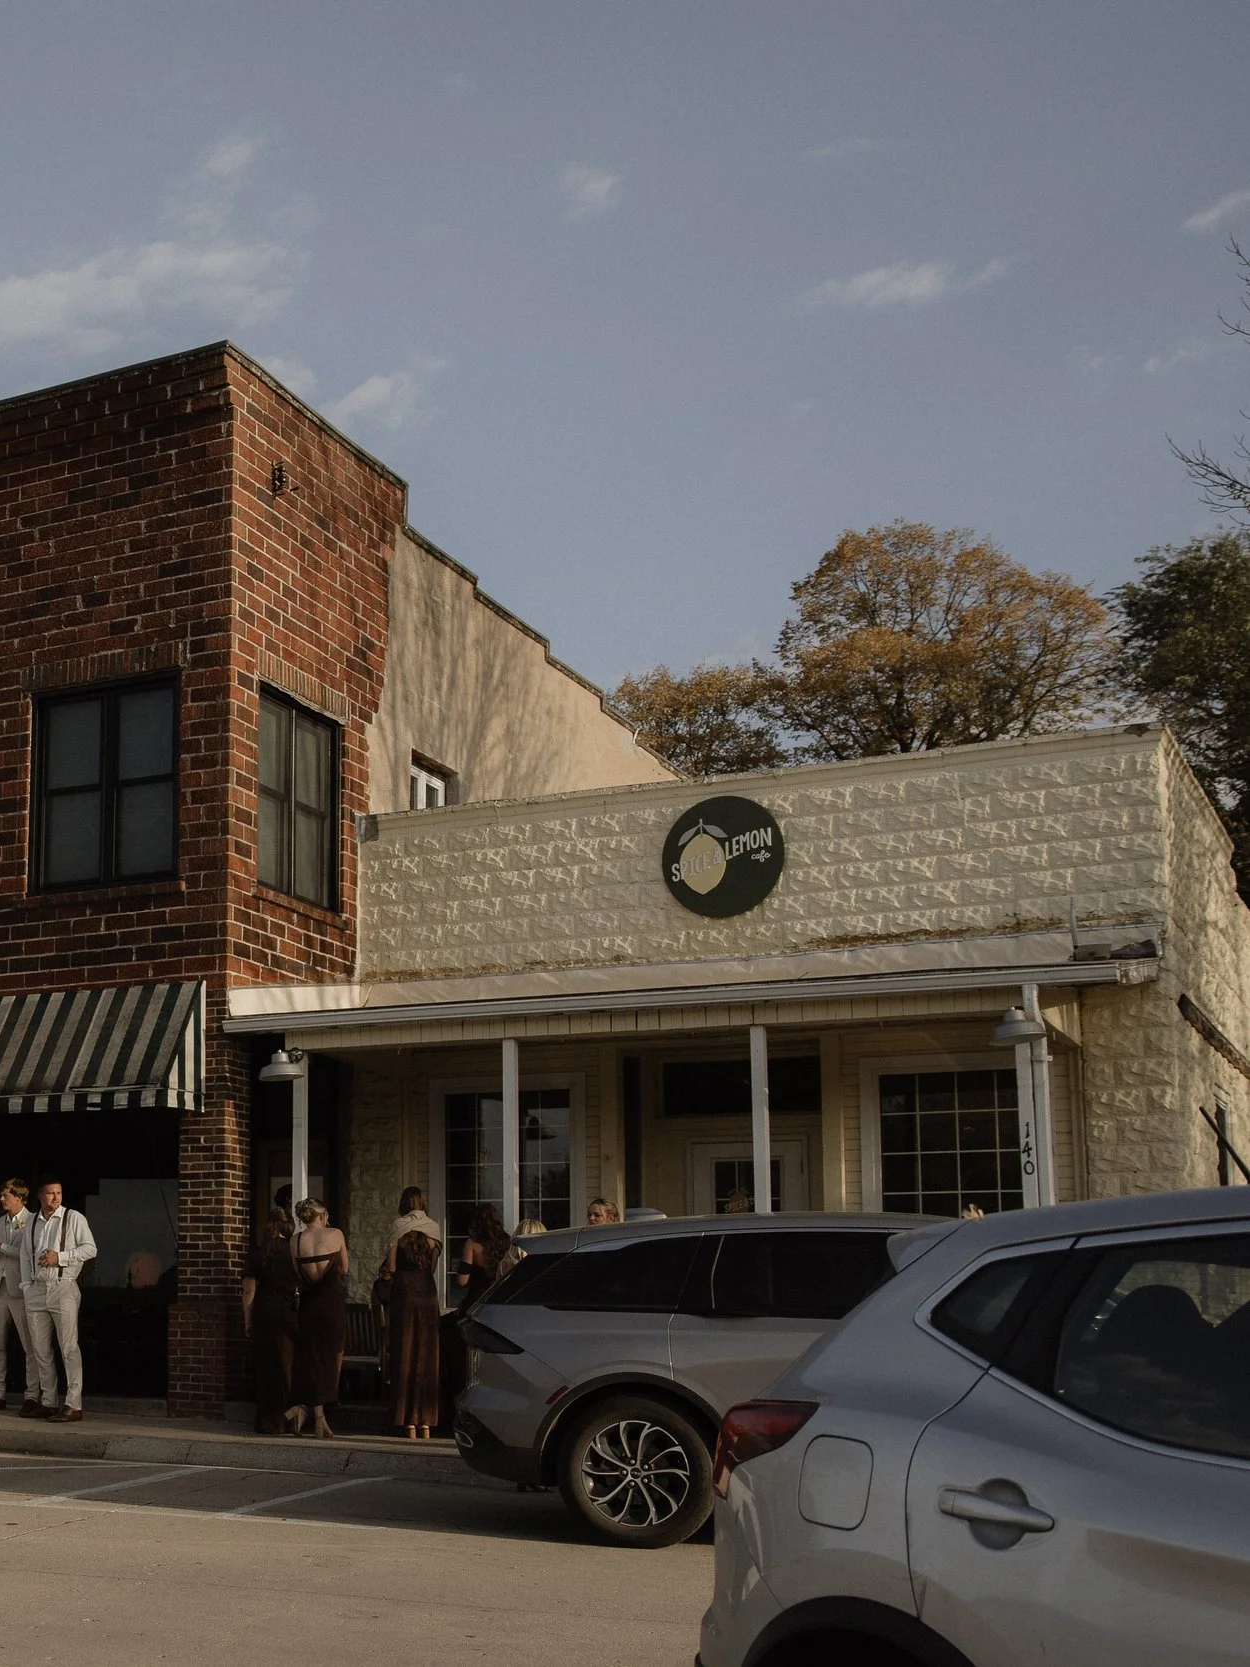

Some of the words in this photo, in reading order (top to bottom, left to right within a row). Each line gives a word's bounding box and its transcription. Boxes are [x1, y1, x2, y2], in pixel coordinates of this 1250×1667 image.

[671, 849, 711, 882] SPICE
[712, 847, 722, 865] &
[725, 827, 773, 860] LEMON
[1021, 1121, 1035, 1175] 140
[724, 1199, 743, 1213] SPICE
